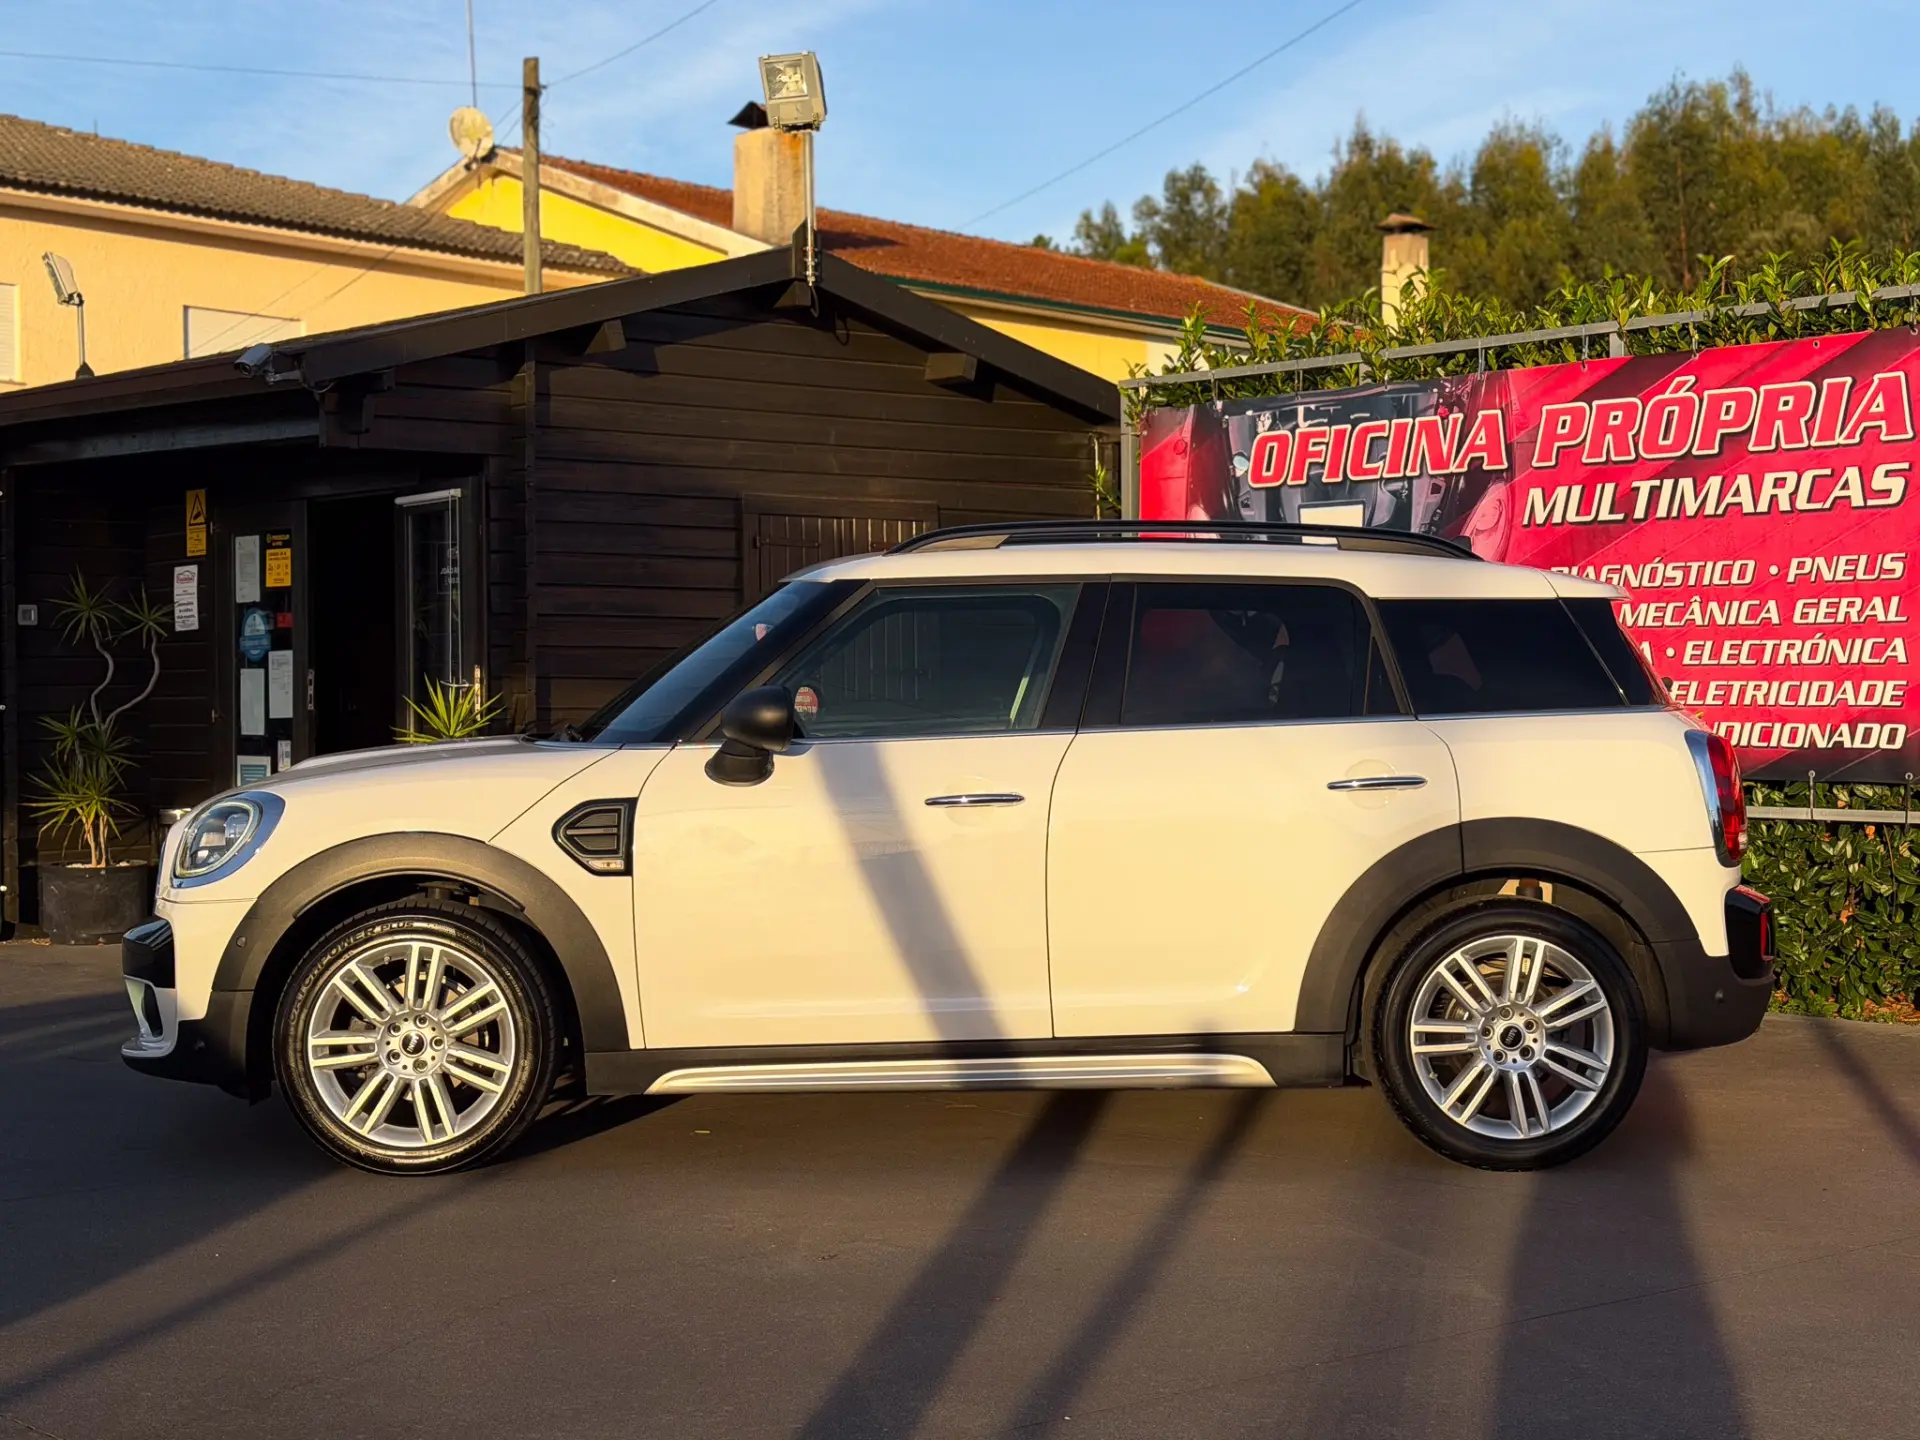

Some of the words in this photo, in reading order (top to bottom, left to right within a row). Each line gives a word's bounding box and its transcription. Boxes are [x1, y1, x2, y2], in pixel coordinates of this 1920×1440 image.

[1248, 410, 1508, 488] OFICINA
[1532, 371, 1913, 468] PRÓPRIA
[1523, 462, 1911, 525] MULTIMARCAS
[1787, 552, 1907, 584] PNEUS
[1618, 596, 1781, 628] MECÂNICA
[1793, 595, 1909, 625] GERAL
[1682, 633, 1909, 666] ELECTRÓNICA
[1671, 680, 1908, 706] ELETRICIDADE
[1713, 721, 1907, 751] DICIONADO
[380, 920, 414, 931] PLUS
